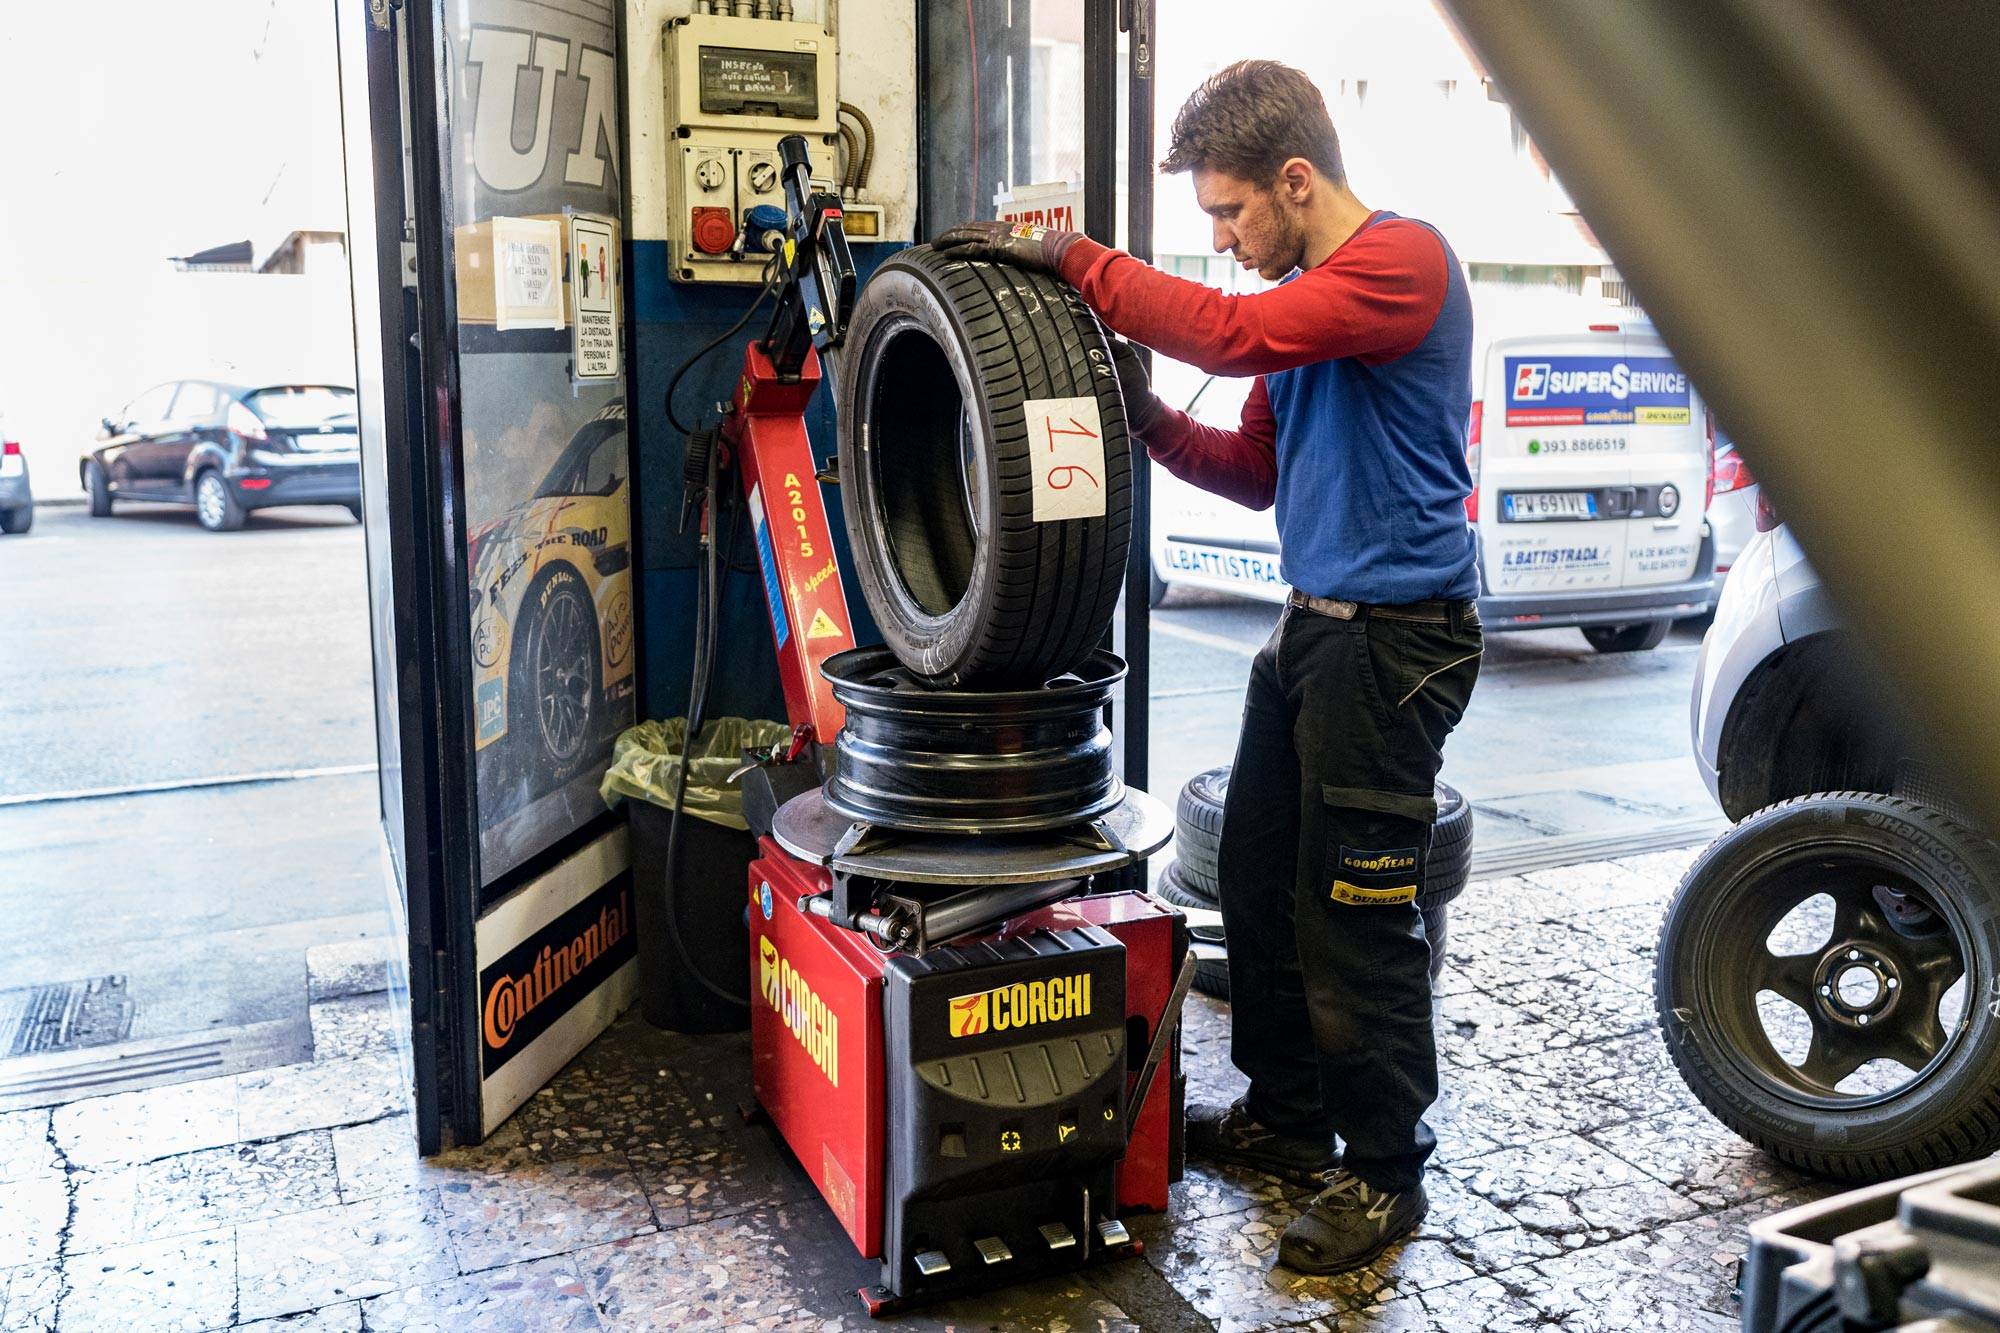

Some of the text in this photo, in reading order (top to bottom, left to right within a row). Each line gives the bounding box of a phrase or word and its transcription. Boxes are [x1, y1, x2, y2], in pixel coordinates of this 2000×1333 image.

[447, 23, 619, 194] UN
[1004, 206, 1074, 232] RATA
[582, 314, 611, 325] MANTENERE
[580, 338, 586, 348] DI
[593, 338, 603, 347] TRA
[603, 339, 614, 348] UNA
[582, 327, 612, 336] LA DISTANZA
[583, 350, 612, 360] PERSONA E
[1045, 416, 1099, 490] 16
[571, 526, 608, 547] ROAD
[804, 557, 837, 592] speed
[1344, 856, 1414, 871] GOODYEAR
[1352, 894, 1409, 904] DUNLOP
[484, 890, 630, 1049] Continental
[992, 973, 1091, 1030] CORGHI
[781, 958, 838, 1088] CORGHI
